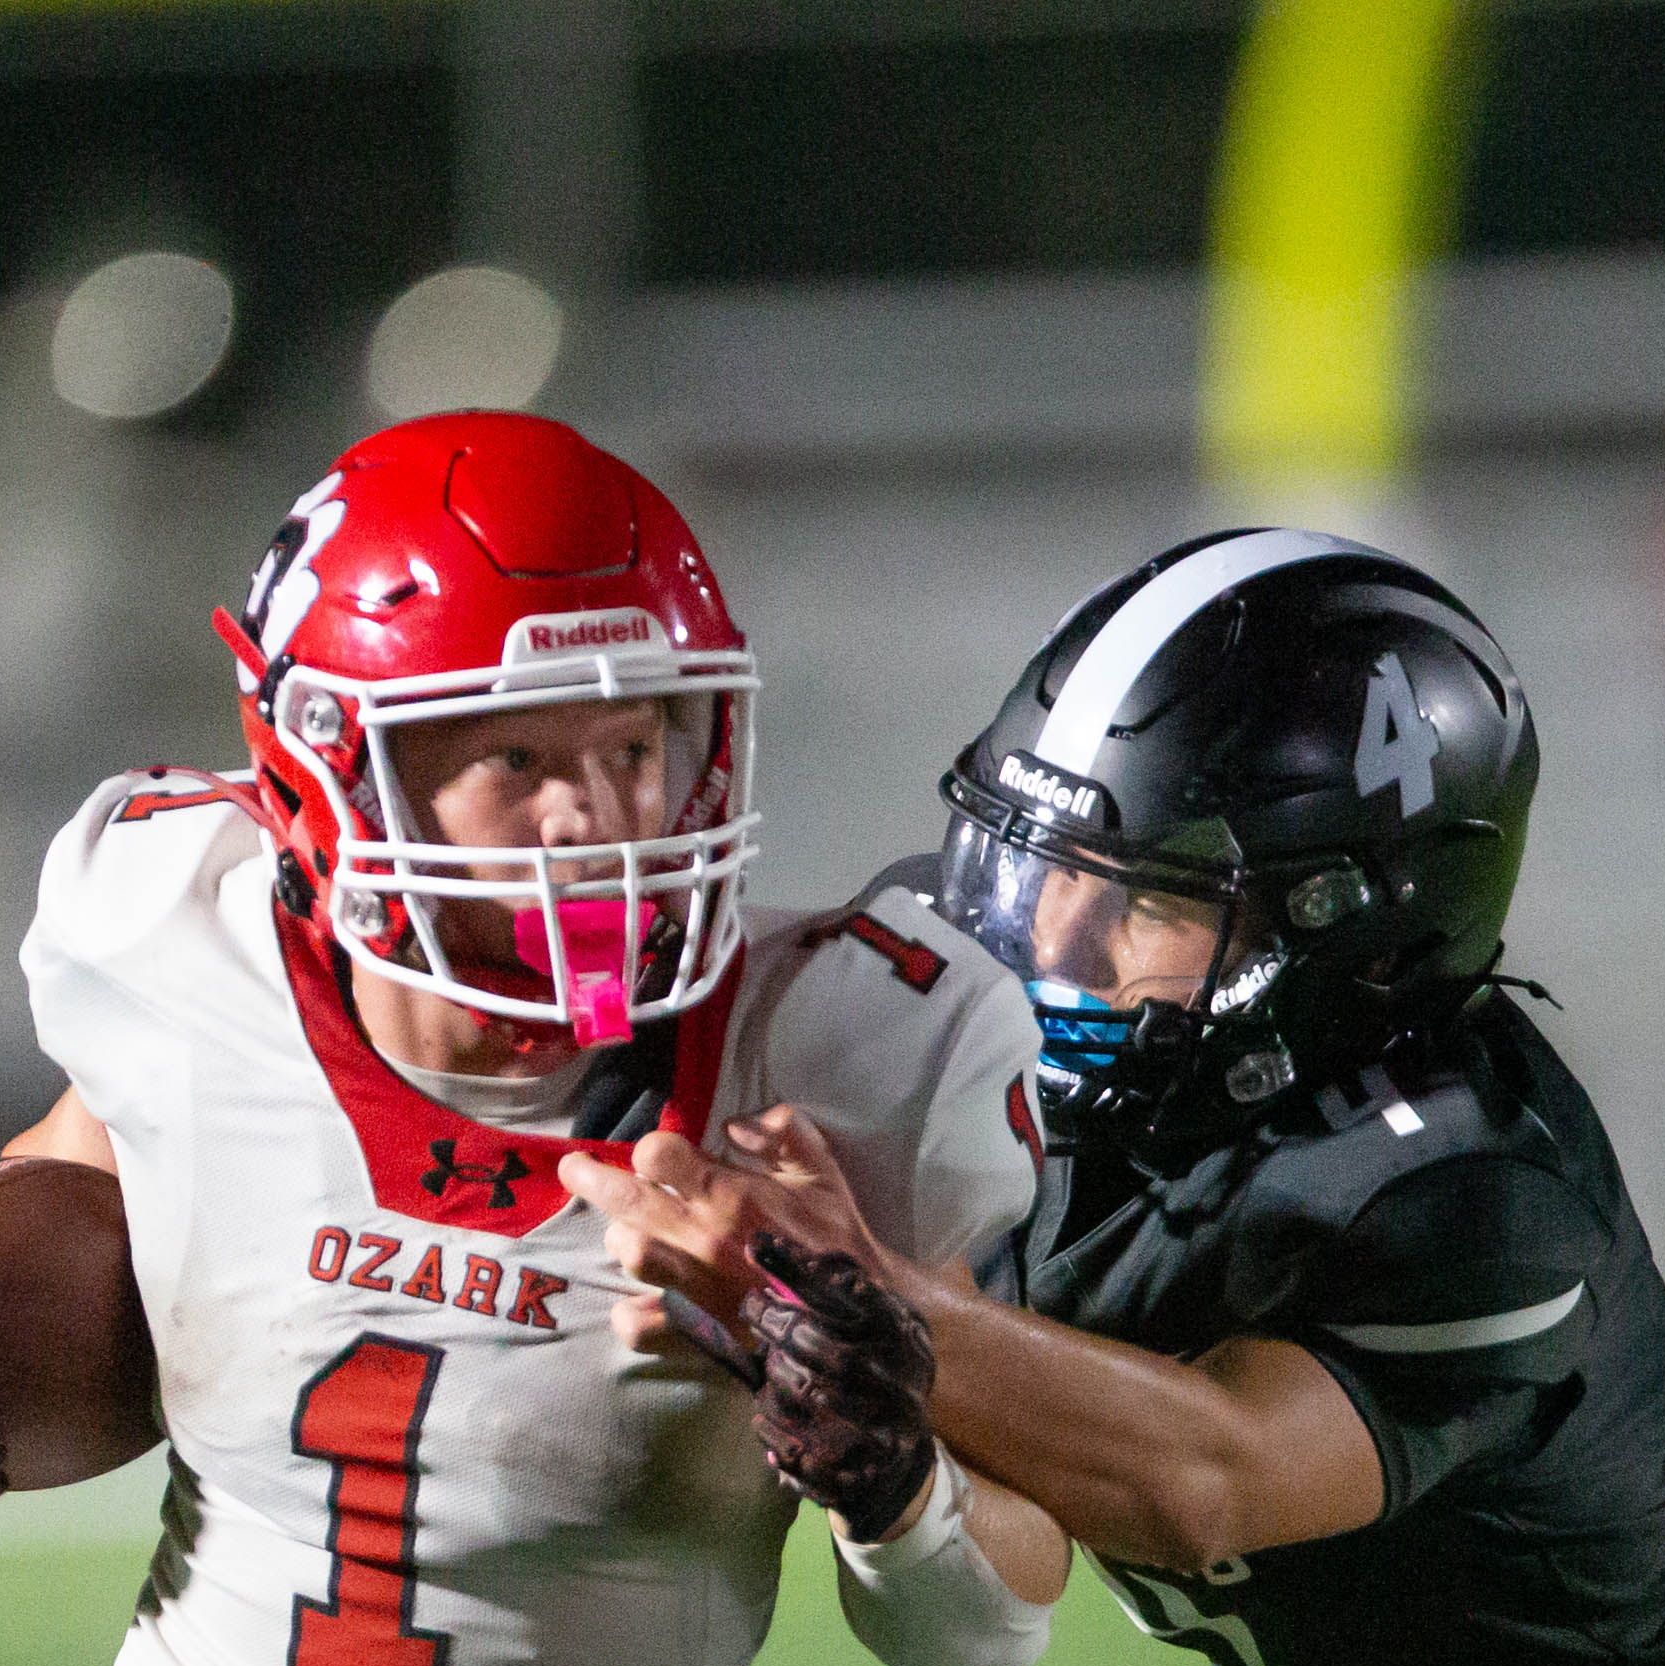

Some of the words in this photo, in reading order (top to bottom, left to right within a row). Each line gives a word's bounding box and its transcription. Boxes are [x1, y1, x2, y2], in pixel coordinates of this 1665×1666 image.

[527, 616, 651, 651] Riddell
[1353, 650, 1441, 820] 4
[998, 754, 1097, 819] Riddell
[1210, 961, 1280, 1015] Ridde
[308, 1225, 569, 1330] OZARK
